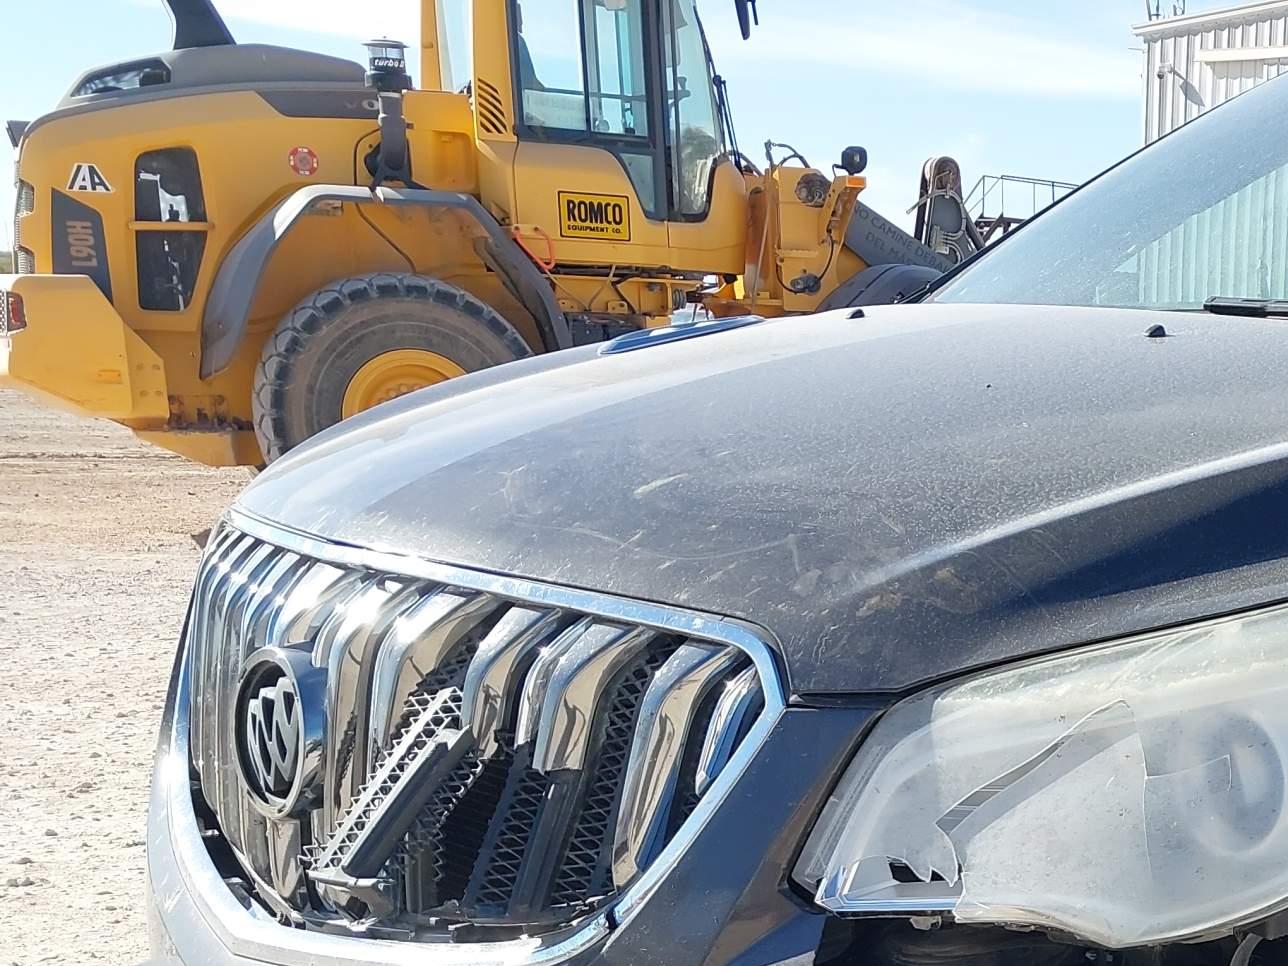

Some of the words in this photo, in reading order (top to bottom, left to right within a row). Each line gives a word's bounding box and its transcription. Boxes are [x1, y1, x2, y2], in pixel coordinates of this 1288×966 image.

[566, 199, 623, 225] ROMCO
[66, 220, 98, 267] L90H
[567, 225, 609, 233] EQUIPMENT
[871, 218, 913, 250] CAMINE
